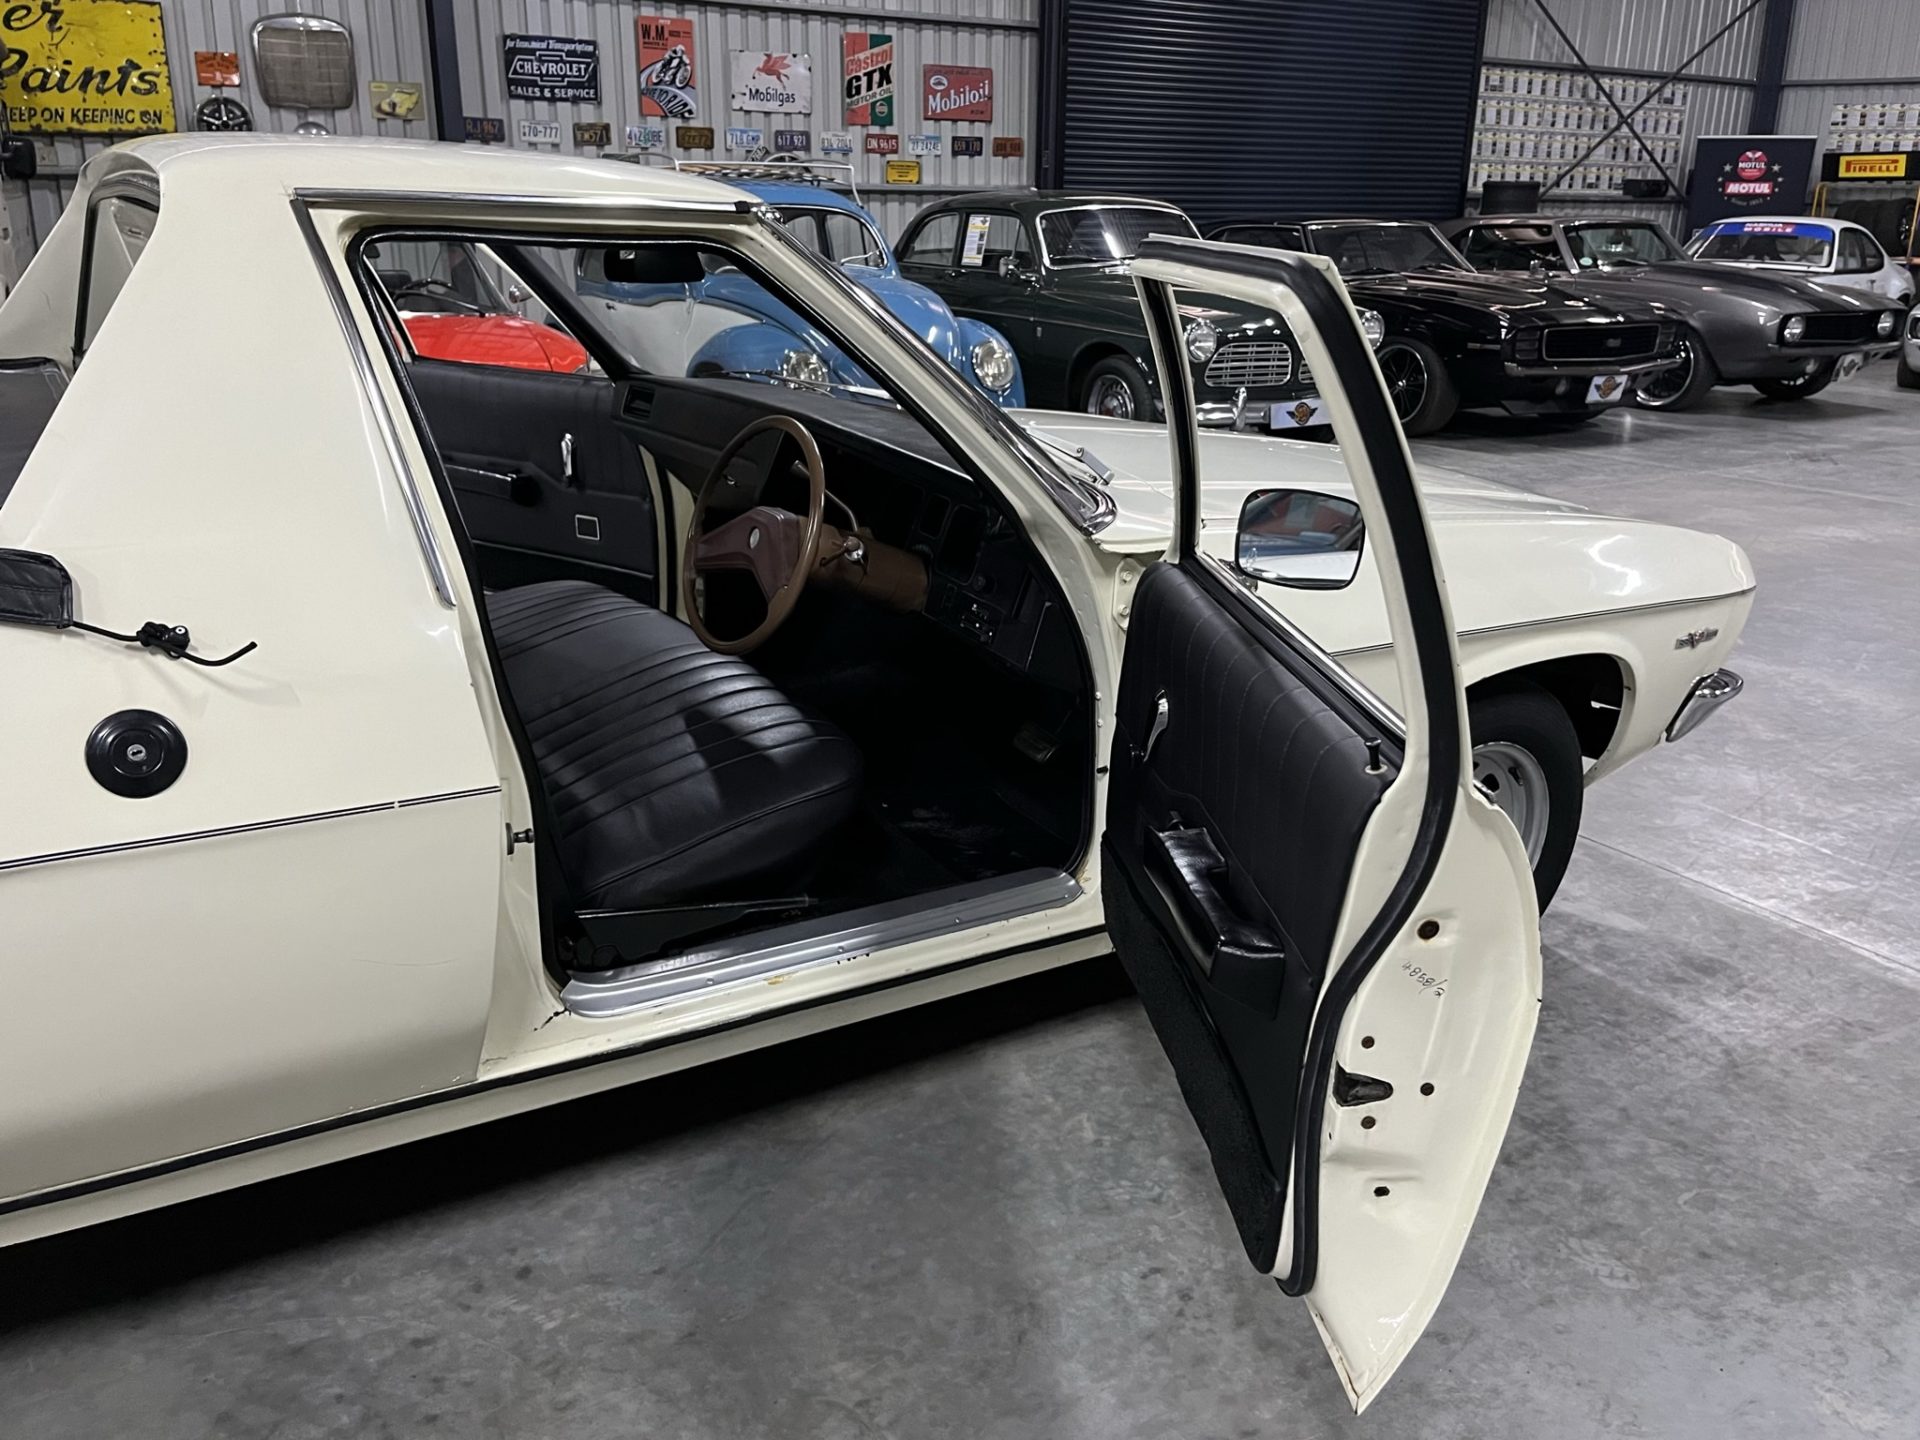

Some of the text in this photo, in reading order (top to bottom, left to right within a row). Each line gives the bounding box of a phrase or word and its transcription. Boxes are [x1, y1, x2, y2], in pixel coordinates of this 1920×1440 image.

[515, 61, 587, 76] CHEVROLET
[846, 63, 893, 99] GTX
[510, 85, 596, 98] SALES & SERVICE
[748, 86, 796, 107] Mobilgas
[847, 86, 894, 107] MOTOR OIL
[927, 79, 989, 116] Mobiloil
[41, 107, 65, 123] ON
[139, 109, 163, 125] ON
[1845, 159, 1899, 173] PIRELLI
[1726, 183, 1770, 193] MOTUL
